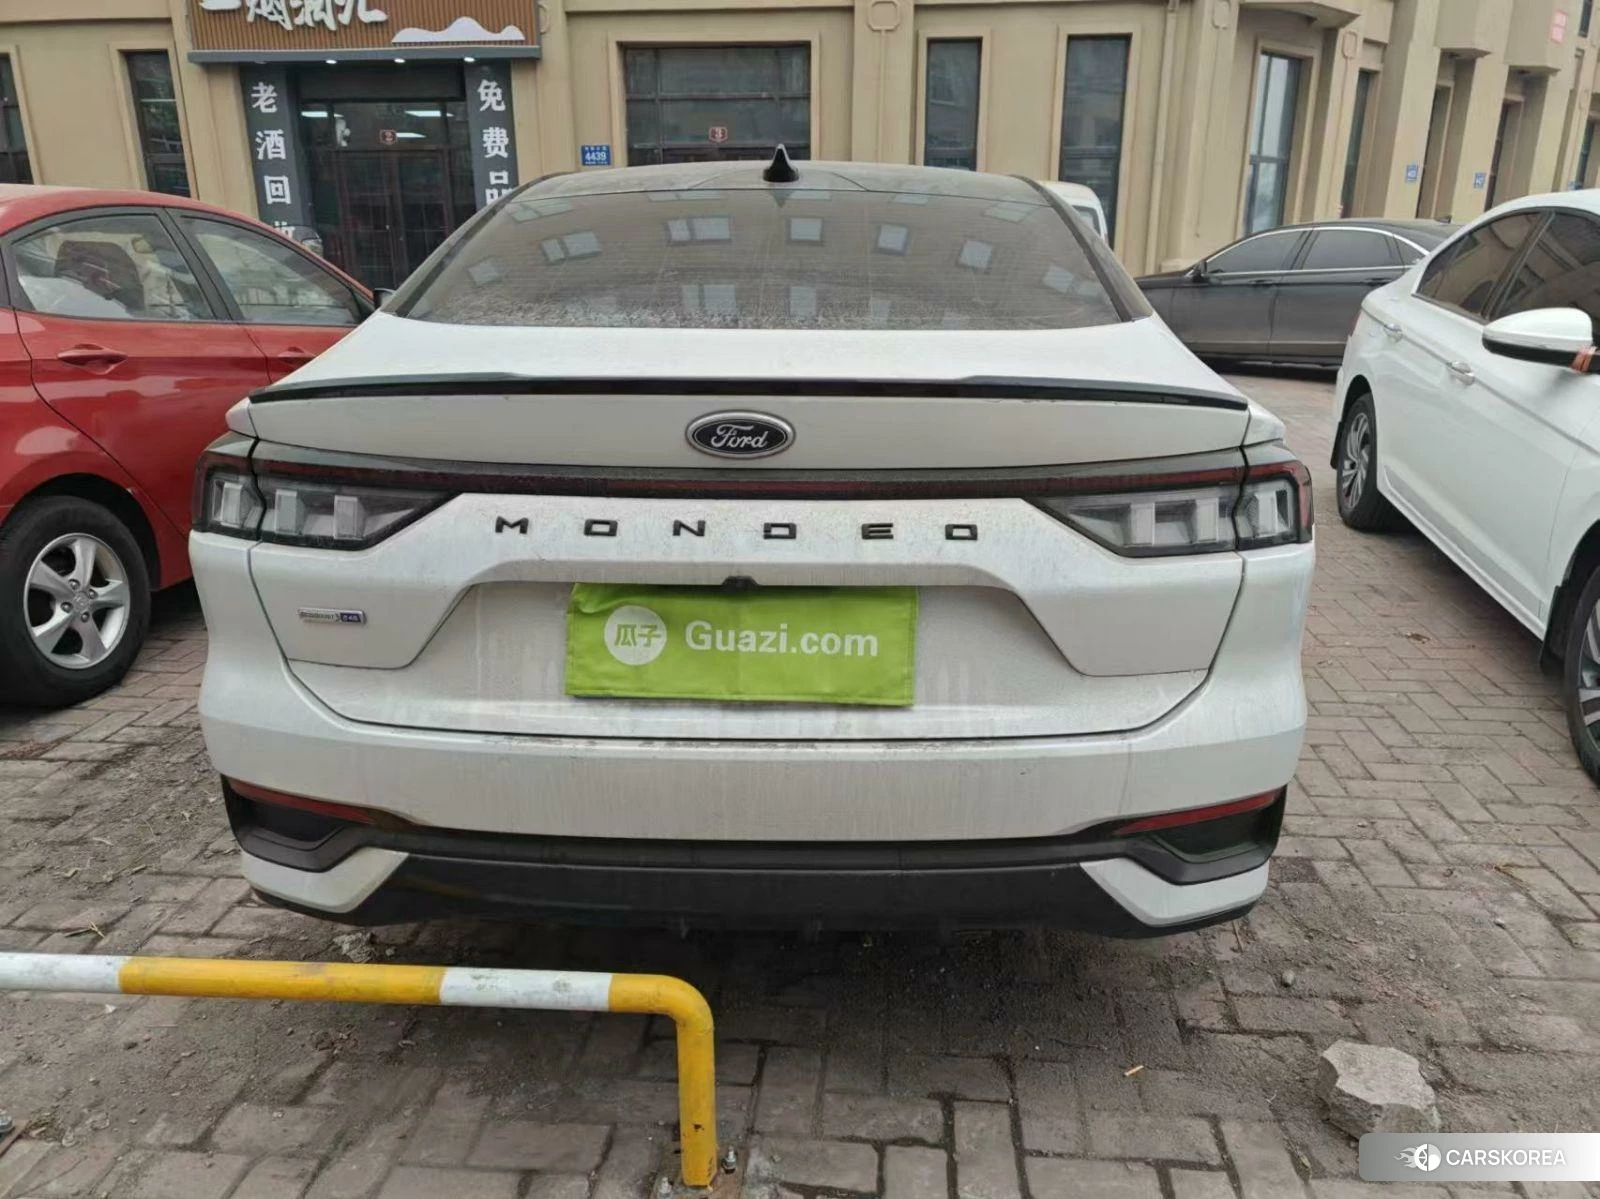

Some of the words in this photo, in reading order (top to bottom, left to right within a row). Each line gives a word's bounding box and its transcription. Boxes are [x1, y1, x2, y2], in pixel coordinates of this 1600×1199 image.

[711, 424, 769, 448] Ford
[494, 517, 979, 540] MONDEO
[614, 623, 662, 648] 瓜子
[685, 619, 879, 657] Guazi.com
